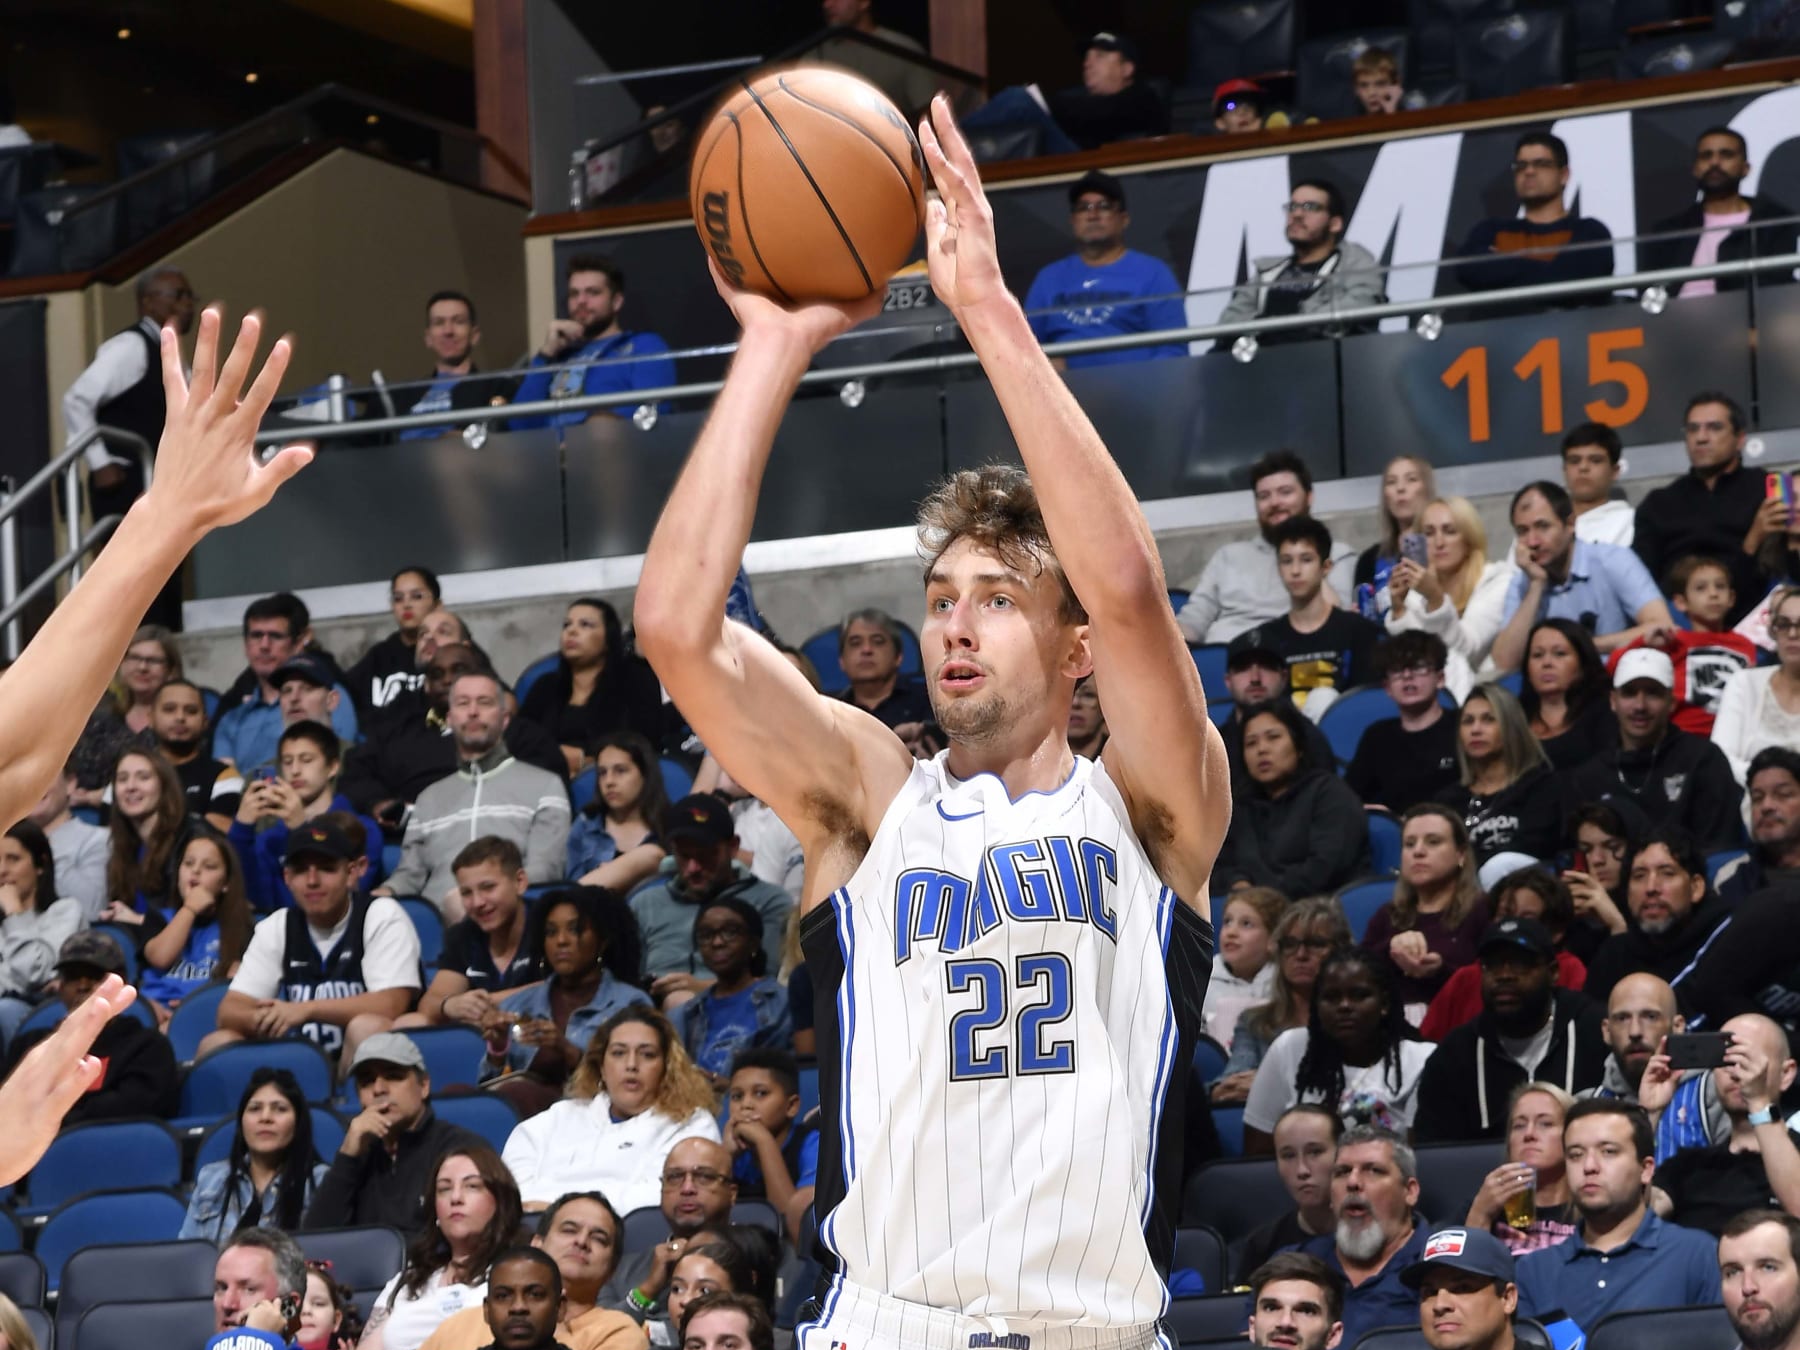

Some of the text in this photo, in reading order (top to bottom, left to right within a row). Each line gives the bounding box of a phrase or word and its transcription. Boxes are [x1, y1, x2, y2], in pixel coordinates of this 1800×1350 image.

[1440, 326, 1650, 443] 115
[895, 835, 1118, 967] MAGIC
[945, 951, 1075, 1082] 22
